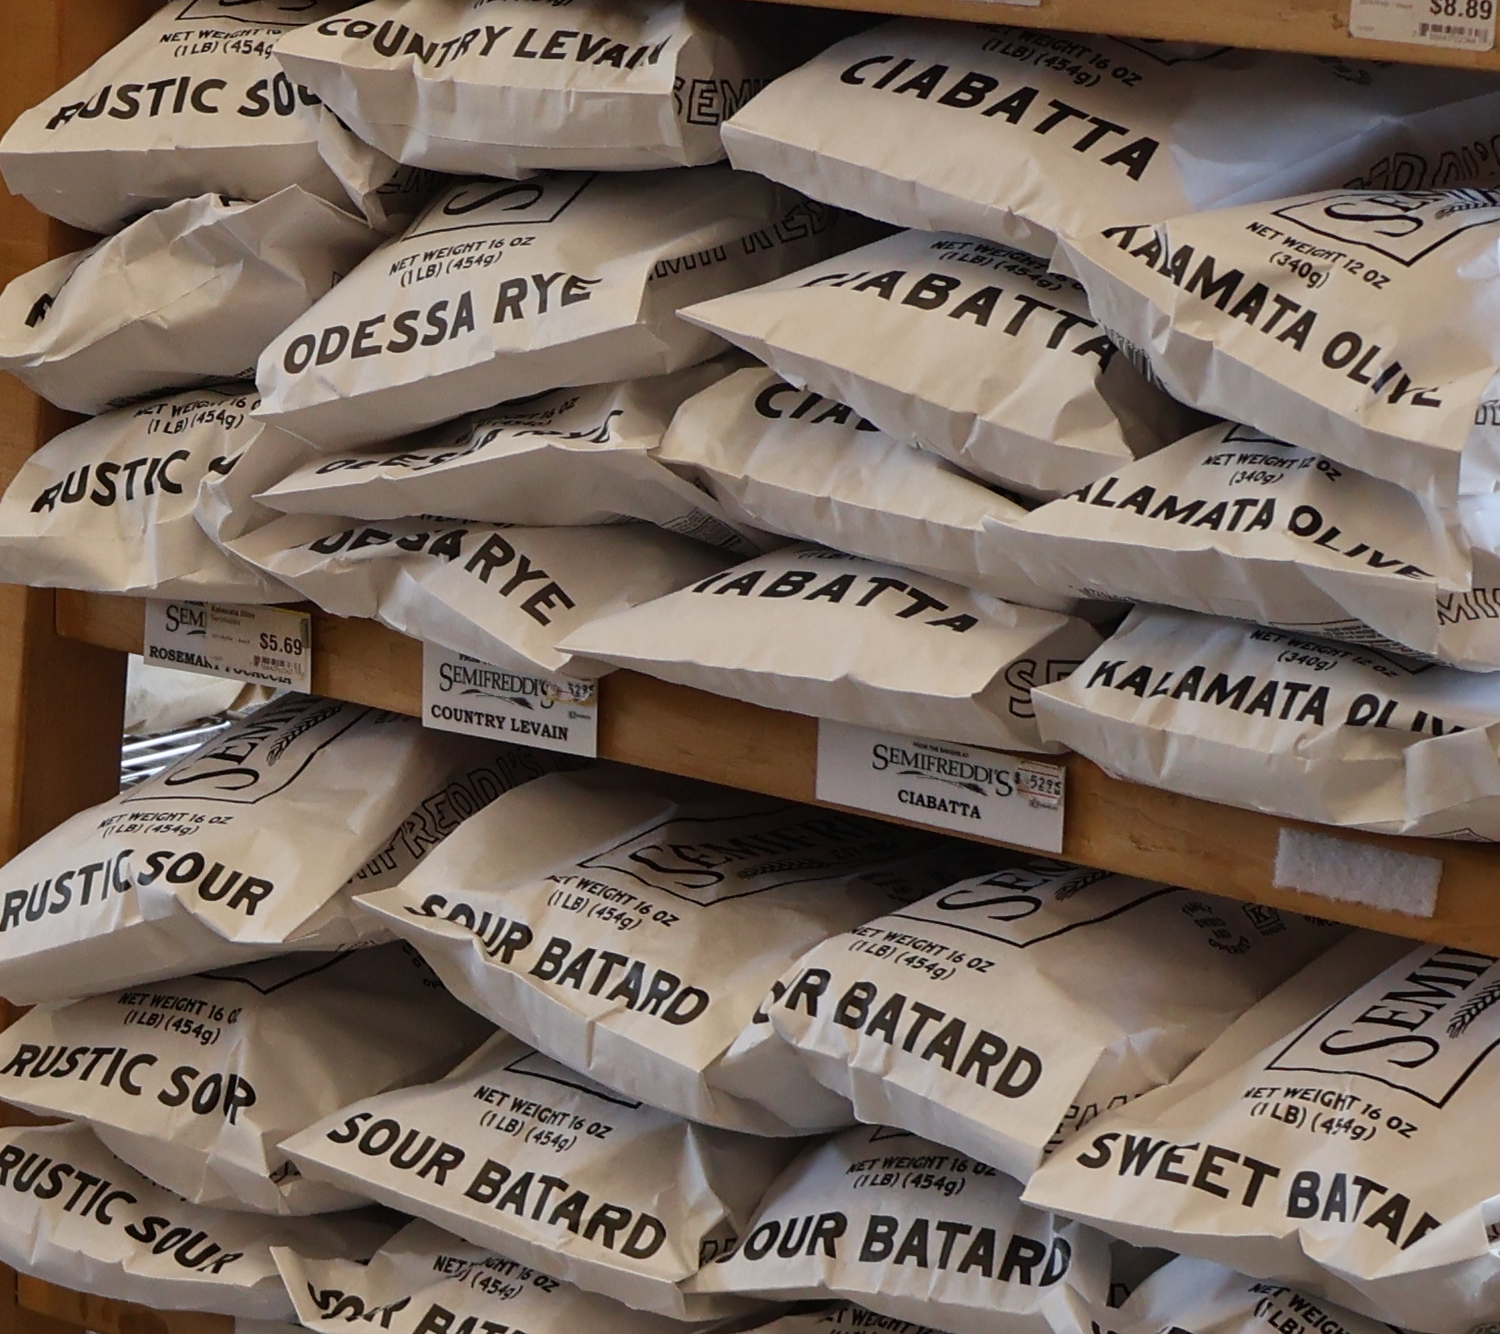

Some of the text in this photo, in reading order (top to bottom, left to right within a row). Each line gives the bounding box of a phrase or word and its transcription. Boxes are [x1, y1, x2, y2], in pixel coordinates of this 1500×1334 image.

[317, 15, 673, 71] COUNTRY LEVAIN
[44, 75, 230, 133] RUSTIC
[838, 53, 1163, 182] CIABATTA
[282, 268, 607, 375] ODESSA RYE
[1287, 503, 1438, 583] OLIVE
[259, 632, 302, 656] $5.69
[431, 704, 569, 741] COUNTRY LEVAIN
[1084, 658, 1329, 728] KALAMATA
[871, 742, 1014, 799] SEMIFREDDI'S
[897, 789, 983, 821] CIABATTA
[133, 849, 275, 917] SOUR
[528, 936, 712, 1028] BATARD
[325, 1111, 465, 1187] SOUR
[1076, 1128, 1282, 1210] SWEET
[463, 1156, 669, 1261] BATARD
